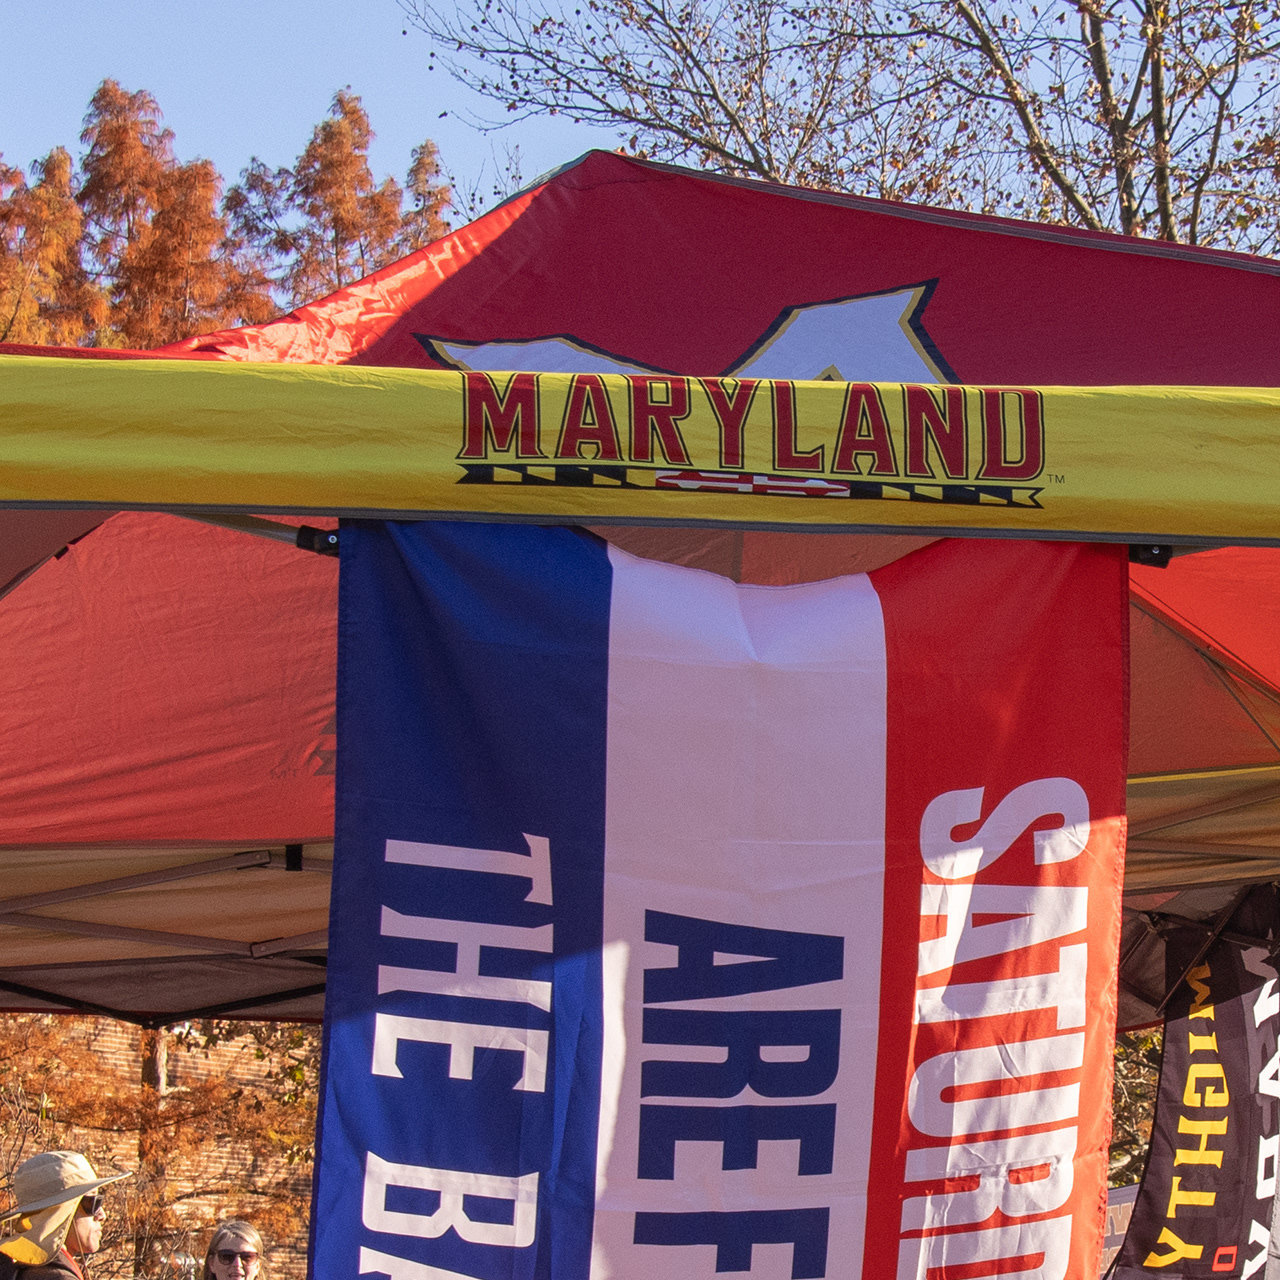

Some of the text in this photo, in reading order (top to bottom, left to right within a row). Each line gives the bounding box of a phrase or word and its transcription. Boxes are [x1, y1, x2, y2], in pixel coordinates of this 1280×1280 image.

[457, 370, 1045, 482] MARYLAND
[371, 831, 554, 1093] THE
[637, 908, 845, 1181] ARE
